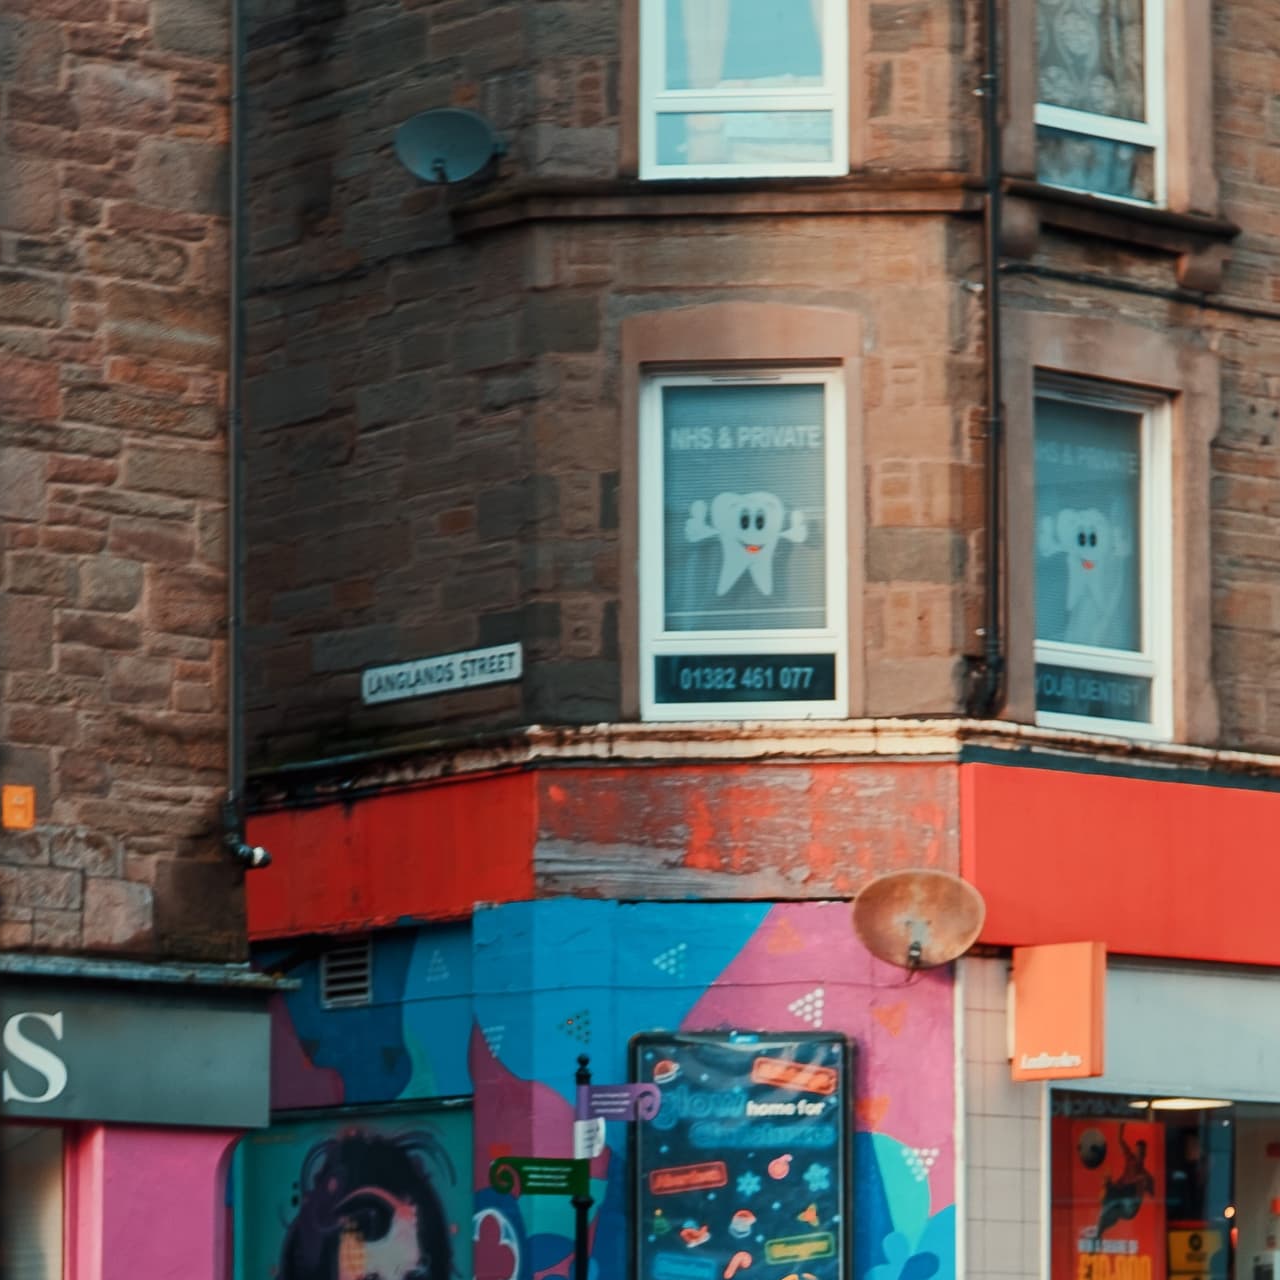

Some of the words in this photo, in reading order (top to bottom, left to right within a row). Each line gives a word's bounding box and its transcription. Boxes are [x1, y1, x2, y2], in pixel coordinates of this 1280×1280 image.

[671, 426, 713, 450] NHS
[717, 426, 732, 450] &
[737, 424, 821, 449] PRIVATE
[368, 663, 453, 695] LANGLANDS
[460, 652, 515, 680] STREET
[680, 667, 736, 690] 01382
[740, 667, 774, 689] 461
[779, 667, 814, 689] 077
[746, 1101, 796, 1116] home
[797, 1100, 826, 1115] for
